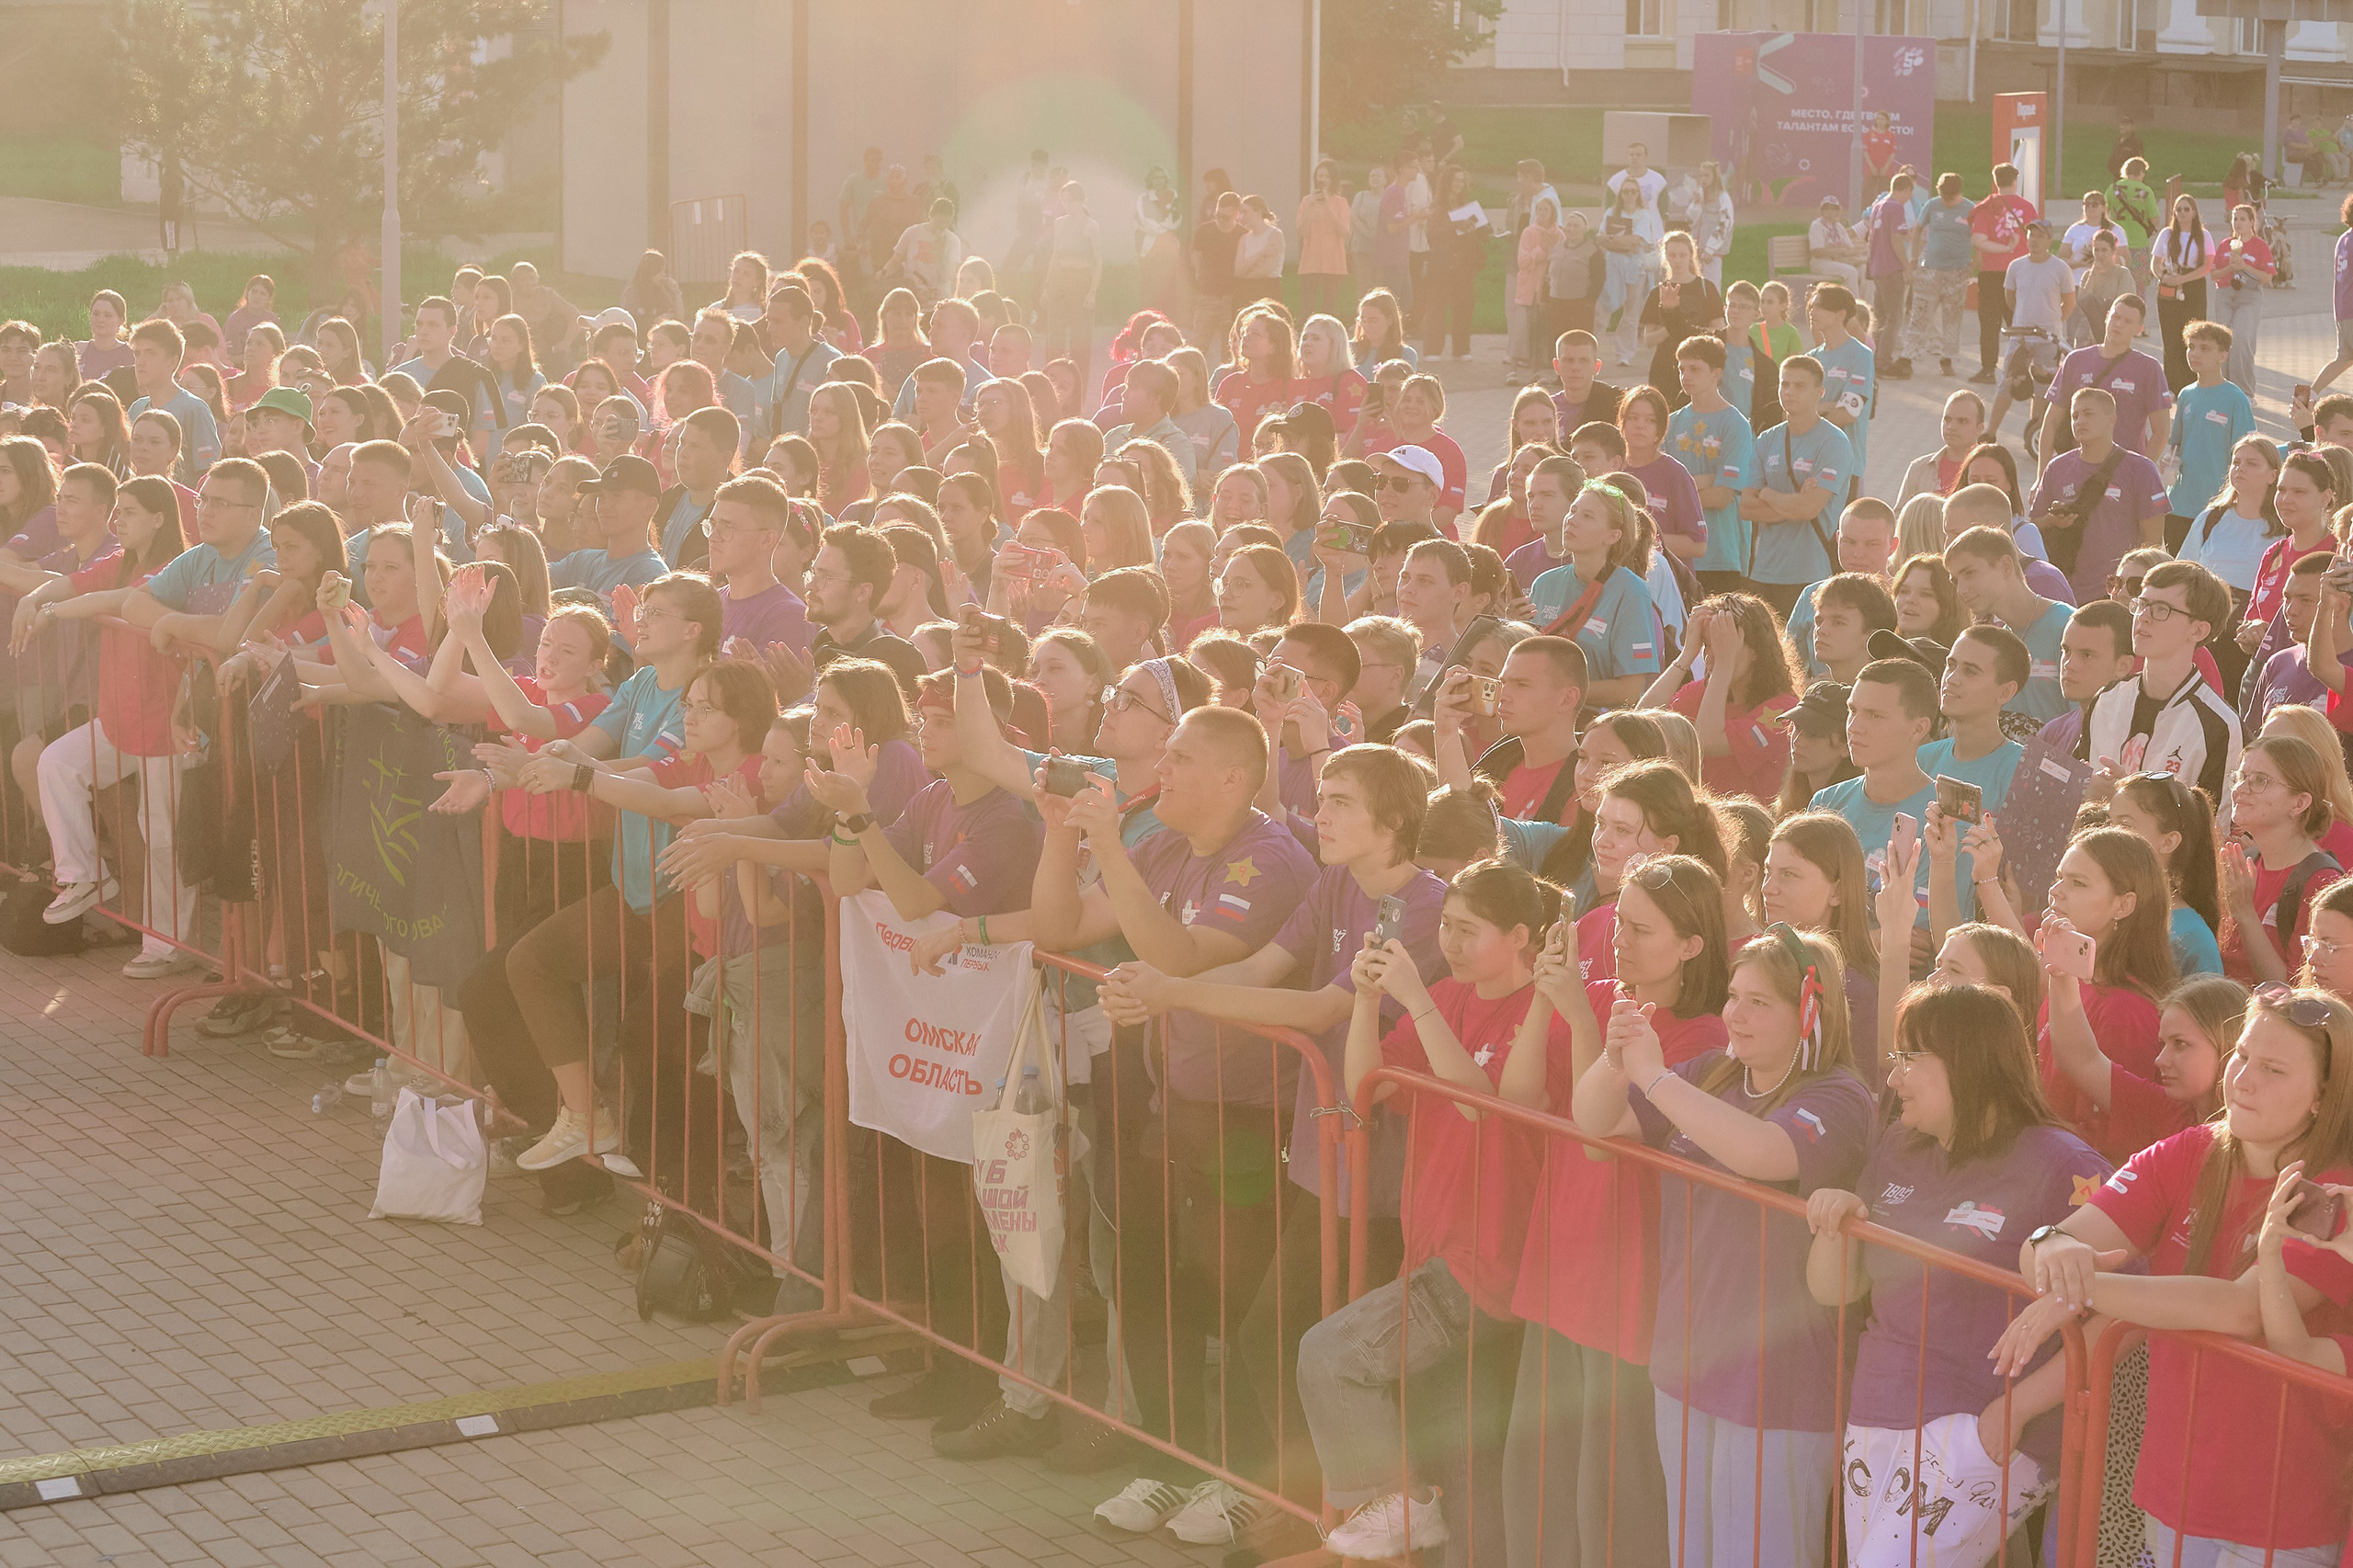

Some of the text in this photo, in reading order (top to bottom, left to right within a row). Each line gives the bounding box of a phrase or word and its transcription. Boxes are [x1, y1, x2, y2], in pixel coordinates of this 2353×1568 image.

[1790, 108, 1833, 120] МЕСТО,
[1777, 120, 1838, 132] ТАЛАНТАМ
[1841, 123, 1869, 133] ЕСЬ
[2165, 760, 2181, 774] 23
[888, 1053, 983, 1096] ОБЛАСТЬ
[978, 1185, 1029, 1210] ШОЙ
